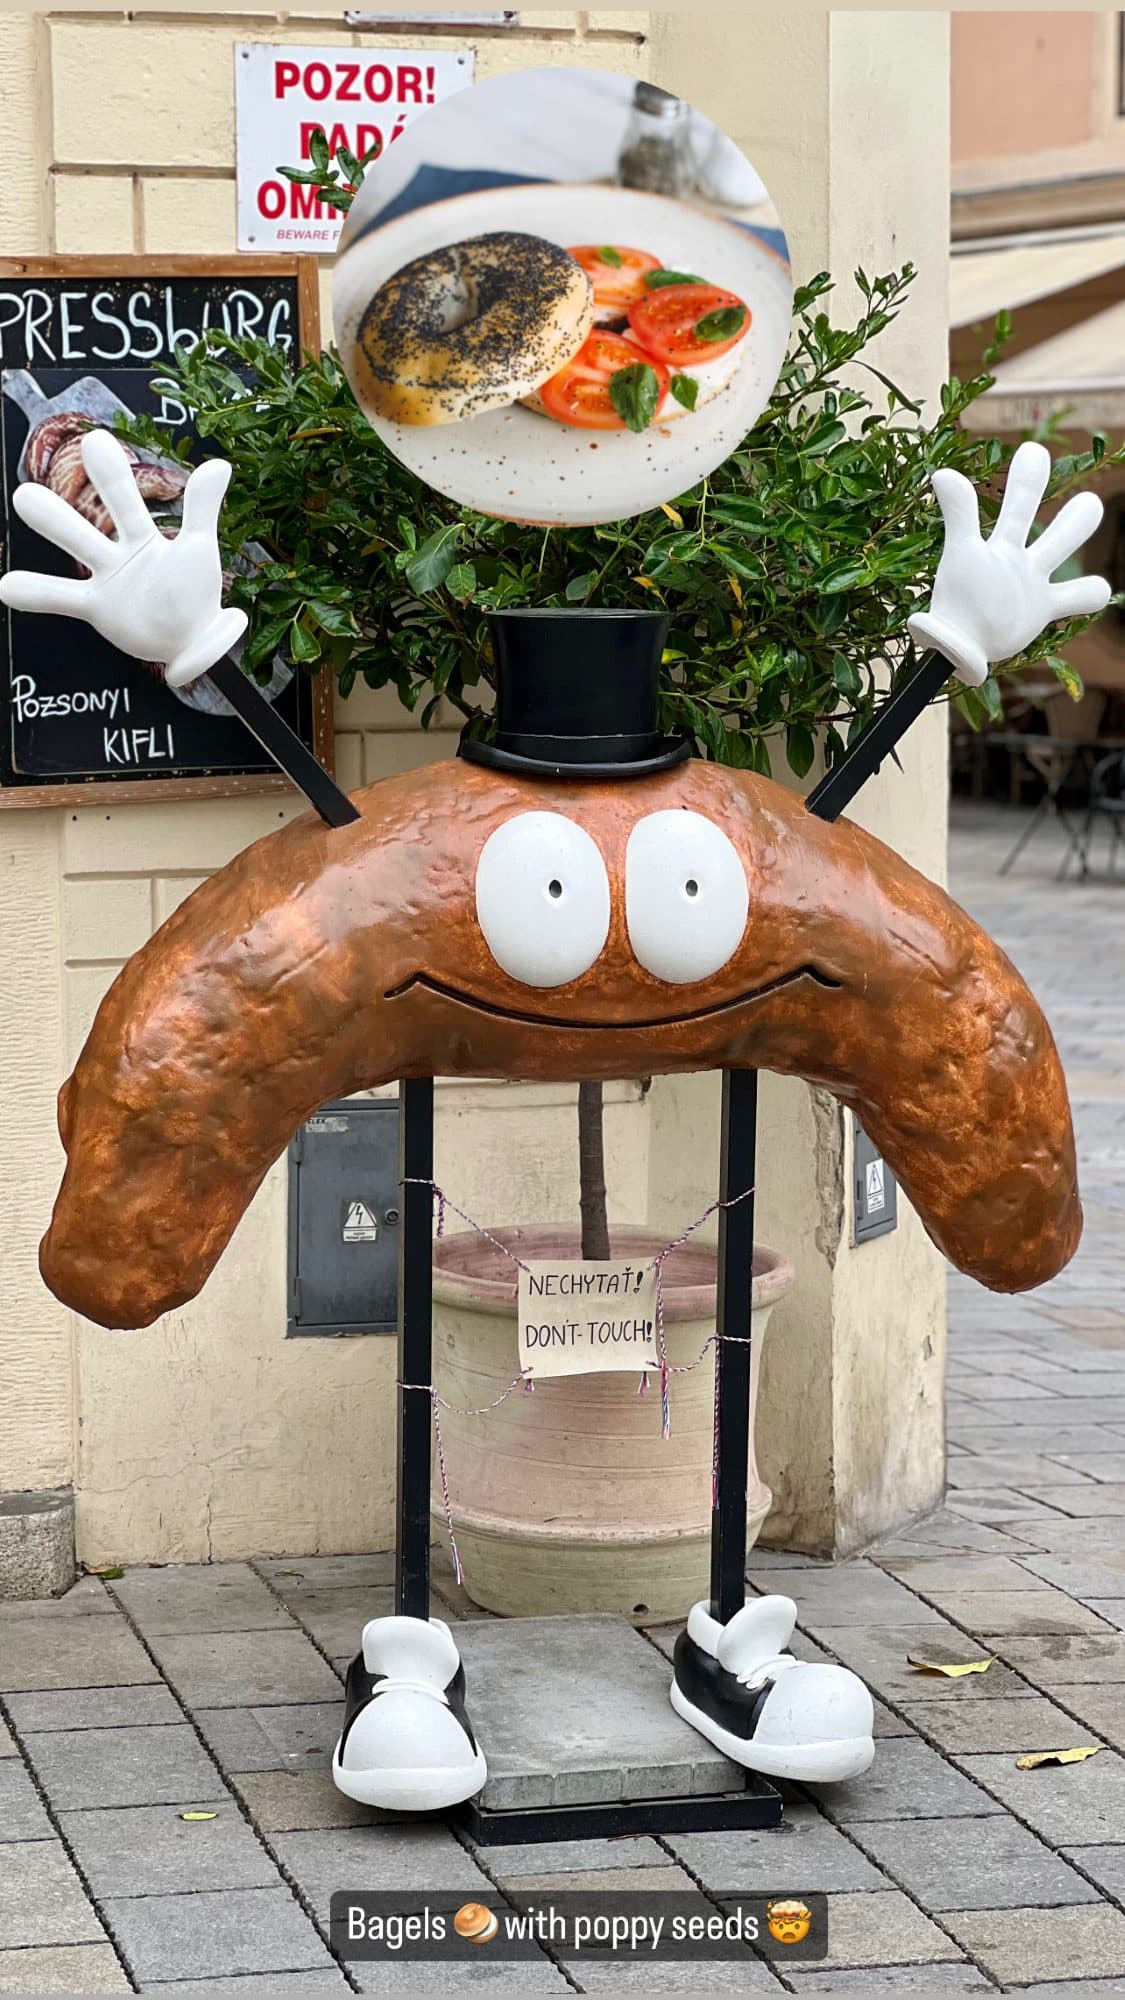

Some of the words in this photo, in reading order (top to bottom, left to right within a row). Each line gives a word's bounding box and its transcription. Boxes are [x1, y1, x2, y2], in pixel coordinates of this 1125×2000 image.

[274, 61, 435, 104] POZOR!
[276, 229, 329, 240] BEWARE
[103, 724, 174, 764] KIFLI
[529, 1266, 644, 1296] NECHYTAŤ!
